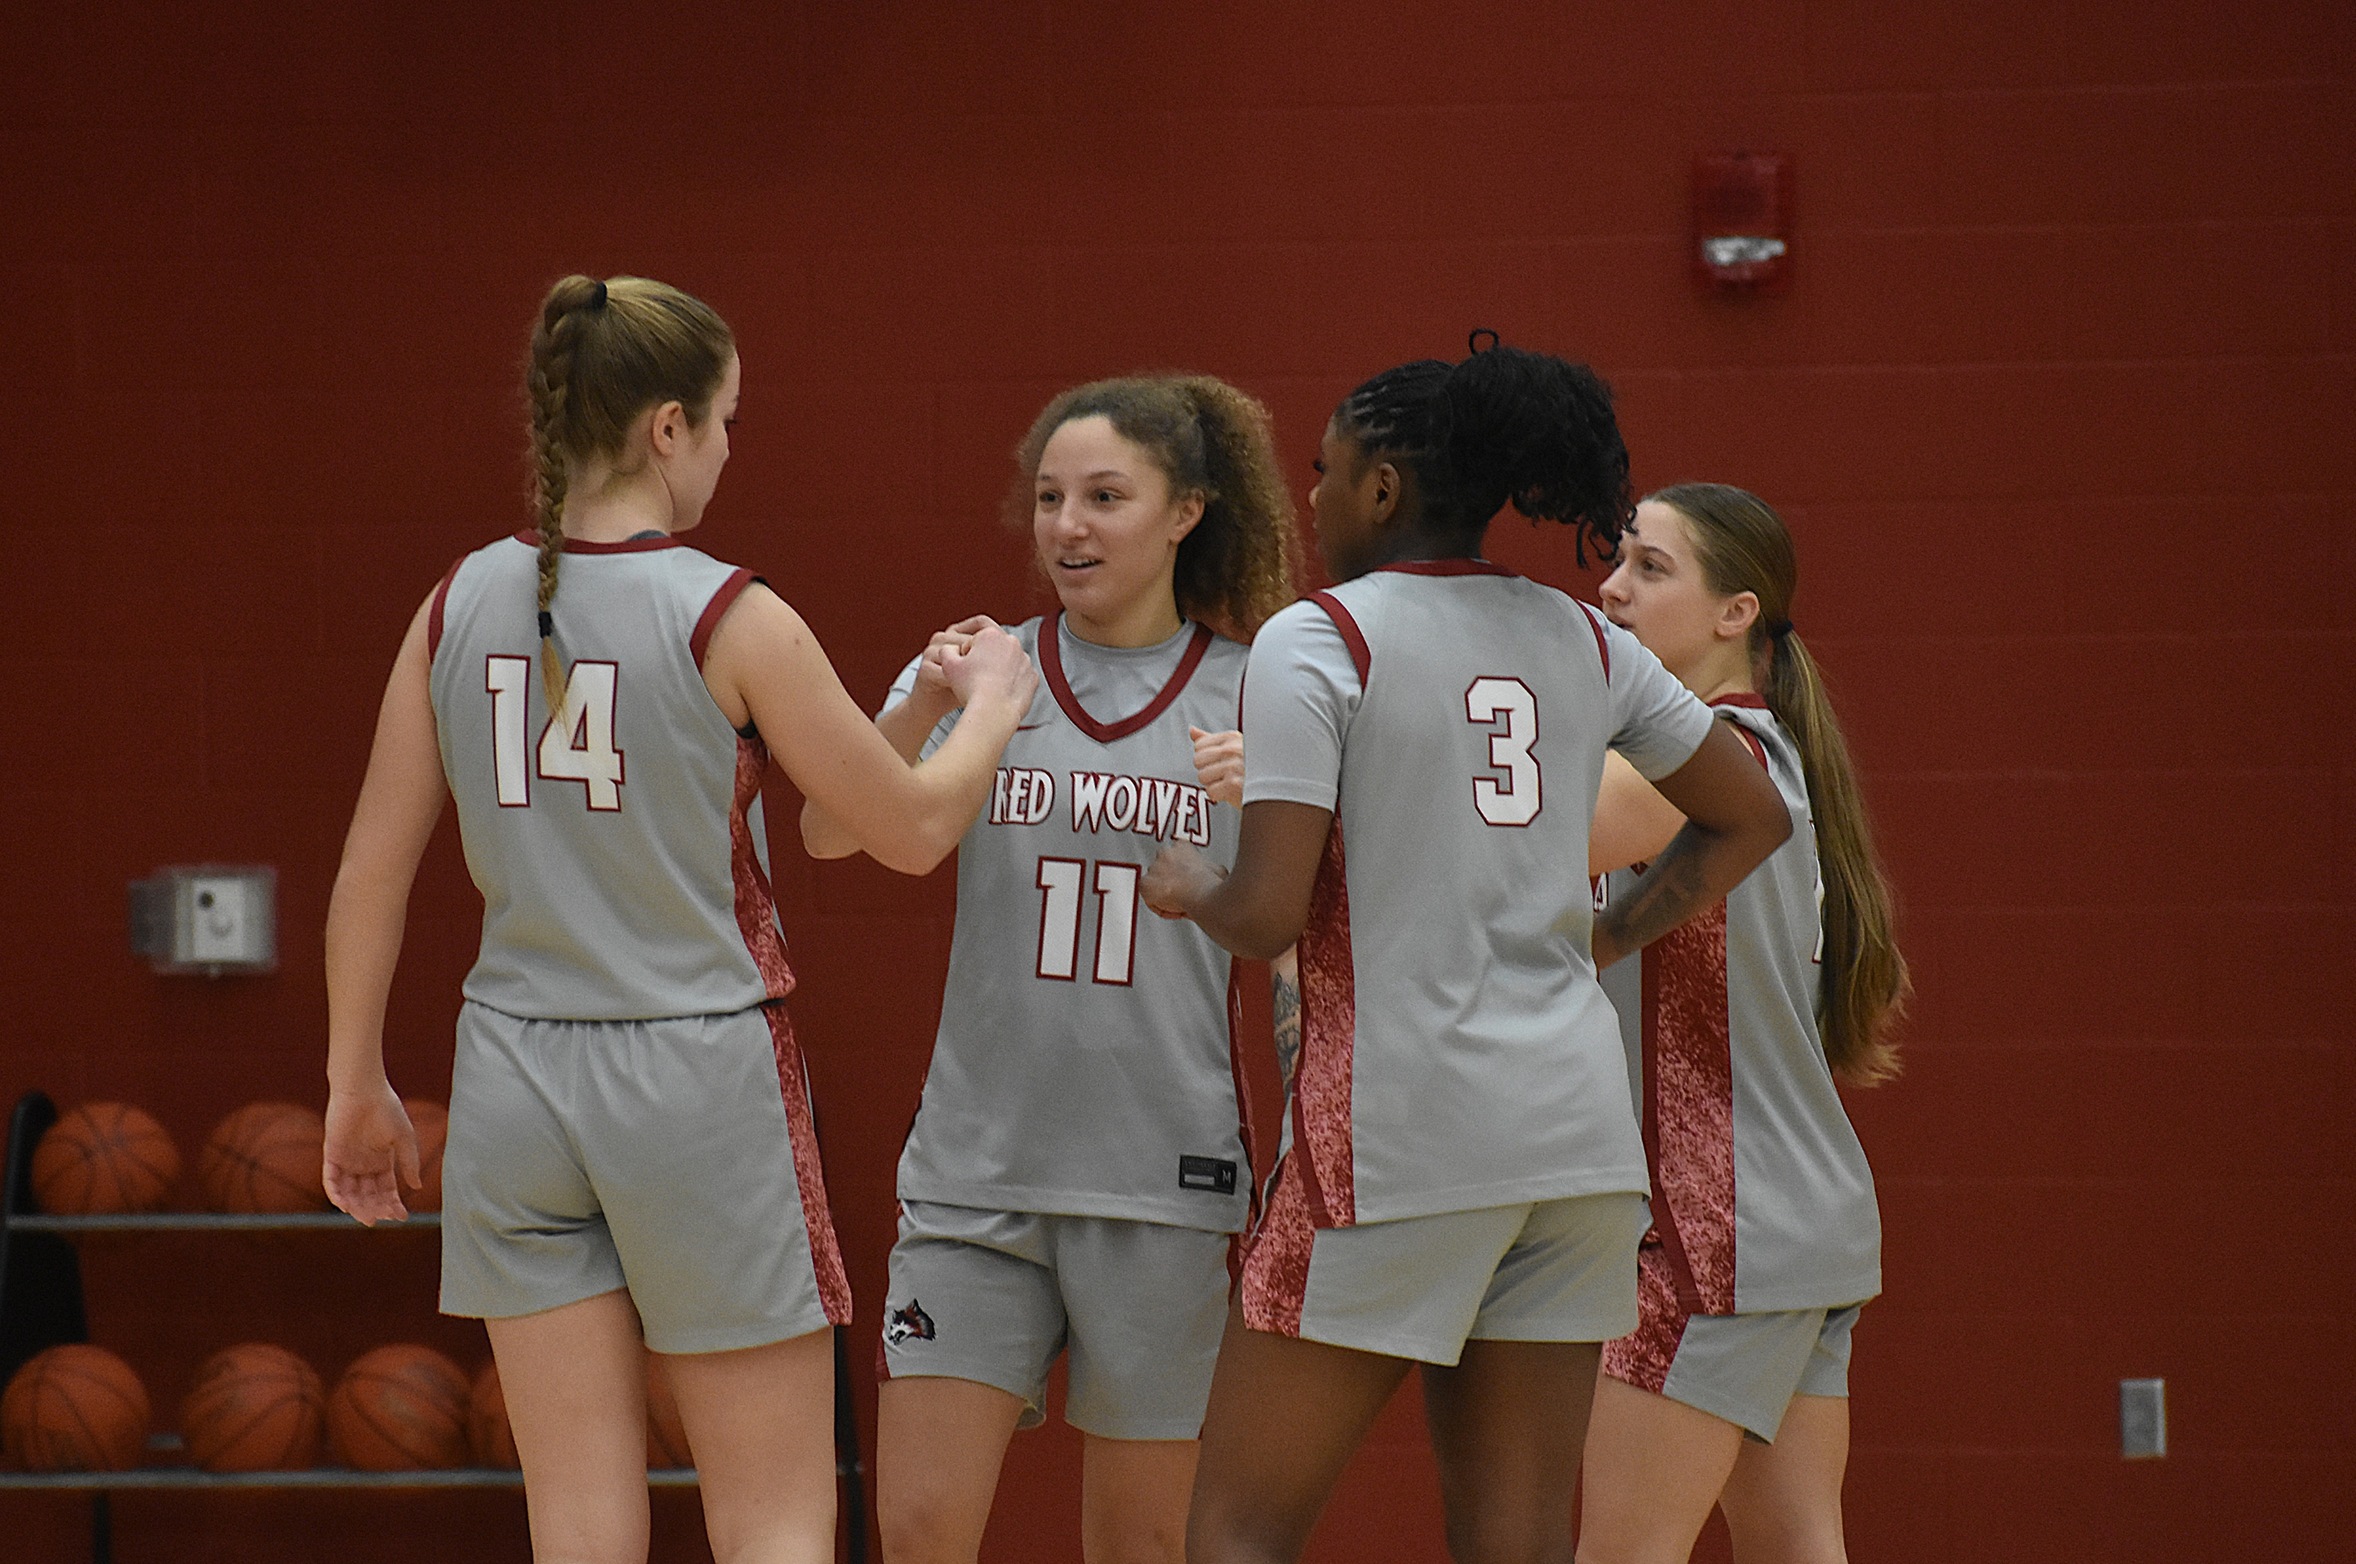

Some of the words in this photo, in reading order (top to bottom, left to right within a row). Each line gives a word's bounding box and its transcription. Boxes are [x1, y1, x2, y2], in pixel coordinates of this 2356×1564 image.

[486, 654, 625, 813] 14
[1465, 675, 1543, 828] 3
[989, 767, 1055, 825] RED
[1071, 770, 1217, 847] WOLVES
[1036, 855, 1142, 987] 11
